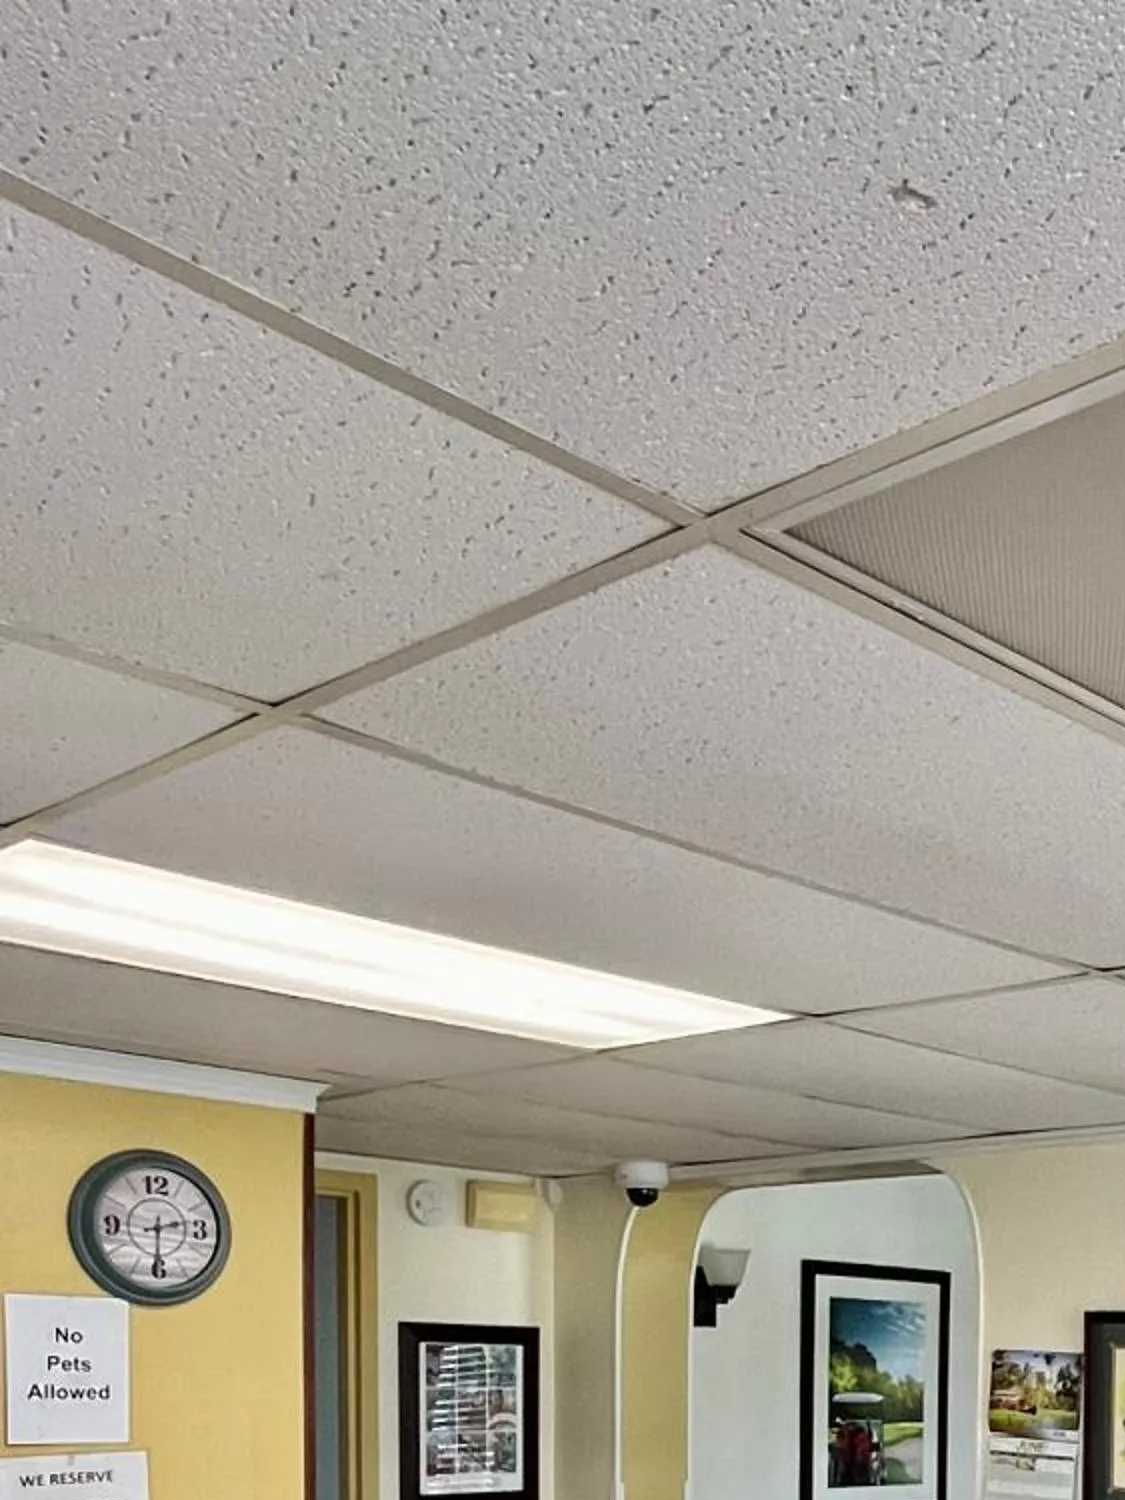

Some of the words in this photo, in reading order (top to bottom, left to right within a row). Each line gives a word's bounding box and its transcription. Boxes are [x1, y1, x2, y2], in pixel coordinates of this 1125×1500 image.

[143, 1175, 169, 1196] 12
[103, 1214, 121, 1236] 9
[193, 1219, 208, 1240] 3
[151, 1258, 167, 1279] 6
[55, 1327, 83, 1344] No
[47, 1355, 92, 1373] Pets
[27, 1383, 111, 1400] Allowed
[19, 1474, 45, 1488] WE
[49, 1469, 113, 1485] RESERVE
